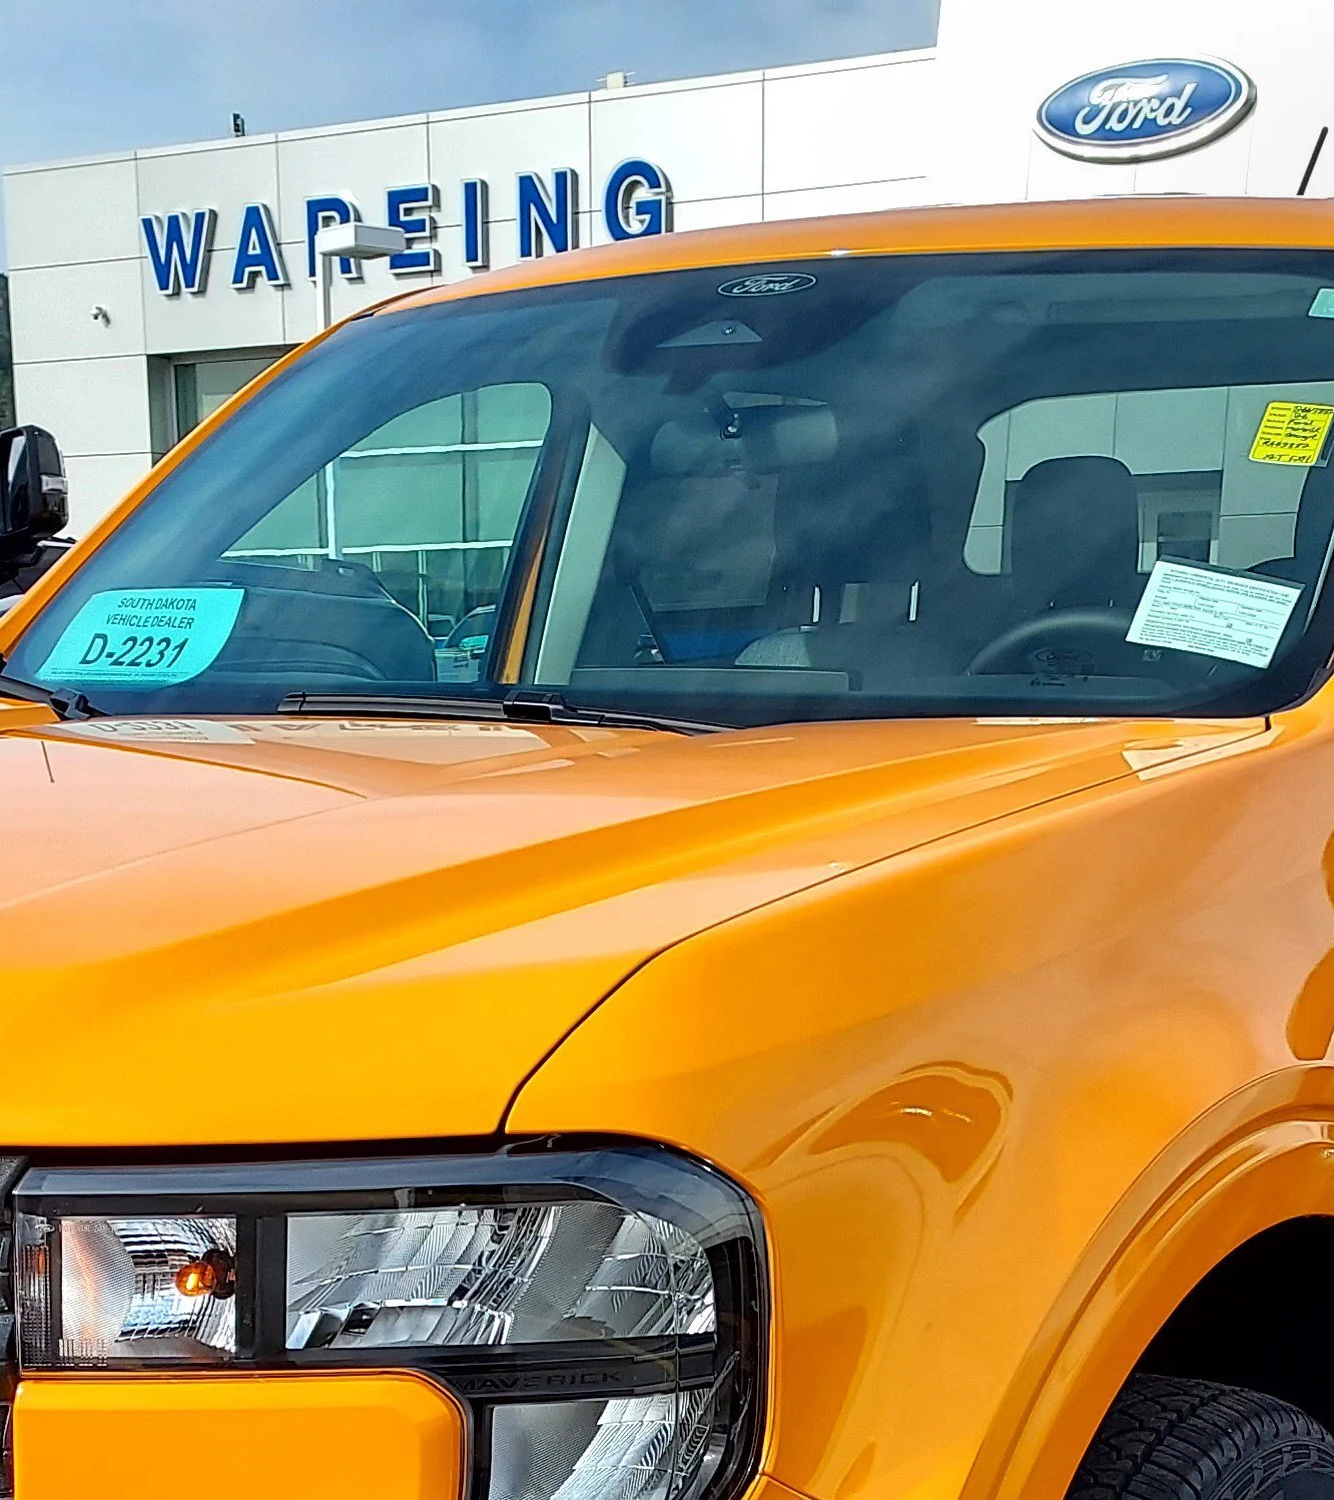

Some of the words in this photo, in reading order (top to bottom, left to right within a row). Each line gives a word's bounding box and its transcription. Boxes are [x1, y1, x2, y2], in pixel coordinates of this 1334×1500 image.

[1074, 73, 1198, 136] Ford
[140, 156, 673, 297] WAREING
[731, 276, 801, 294] Ford
[117, 597, 155, 611] SOUTH
[155, 598, 197, 611] DAKOTA
[105, 613, 153, 628] VEHICLE
[152, 615, 195, 630] DEALER
[78, 633, 190, 668] D-2231
[453, 1371, 621, 1392] MAVERICK
